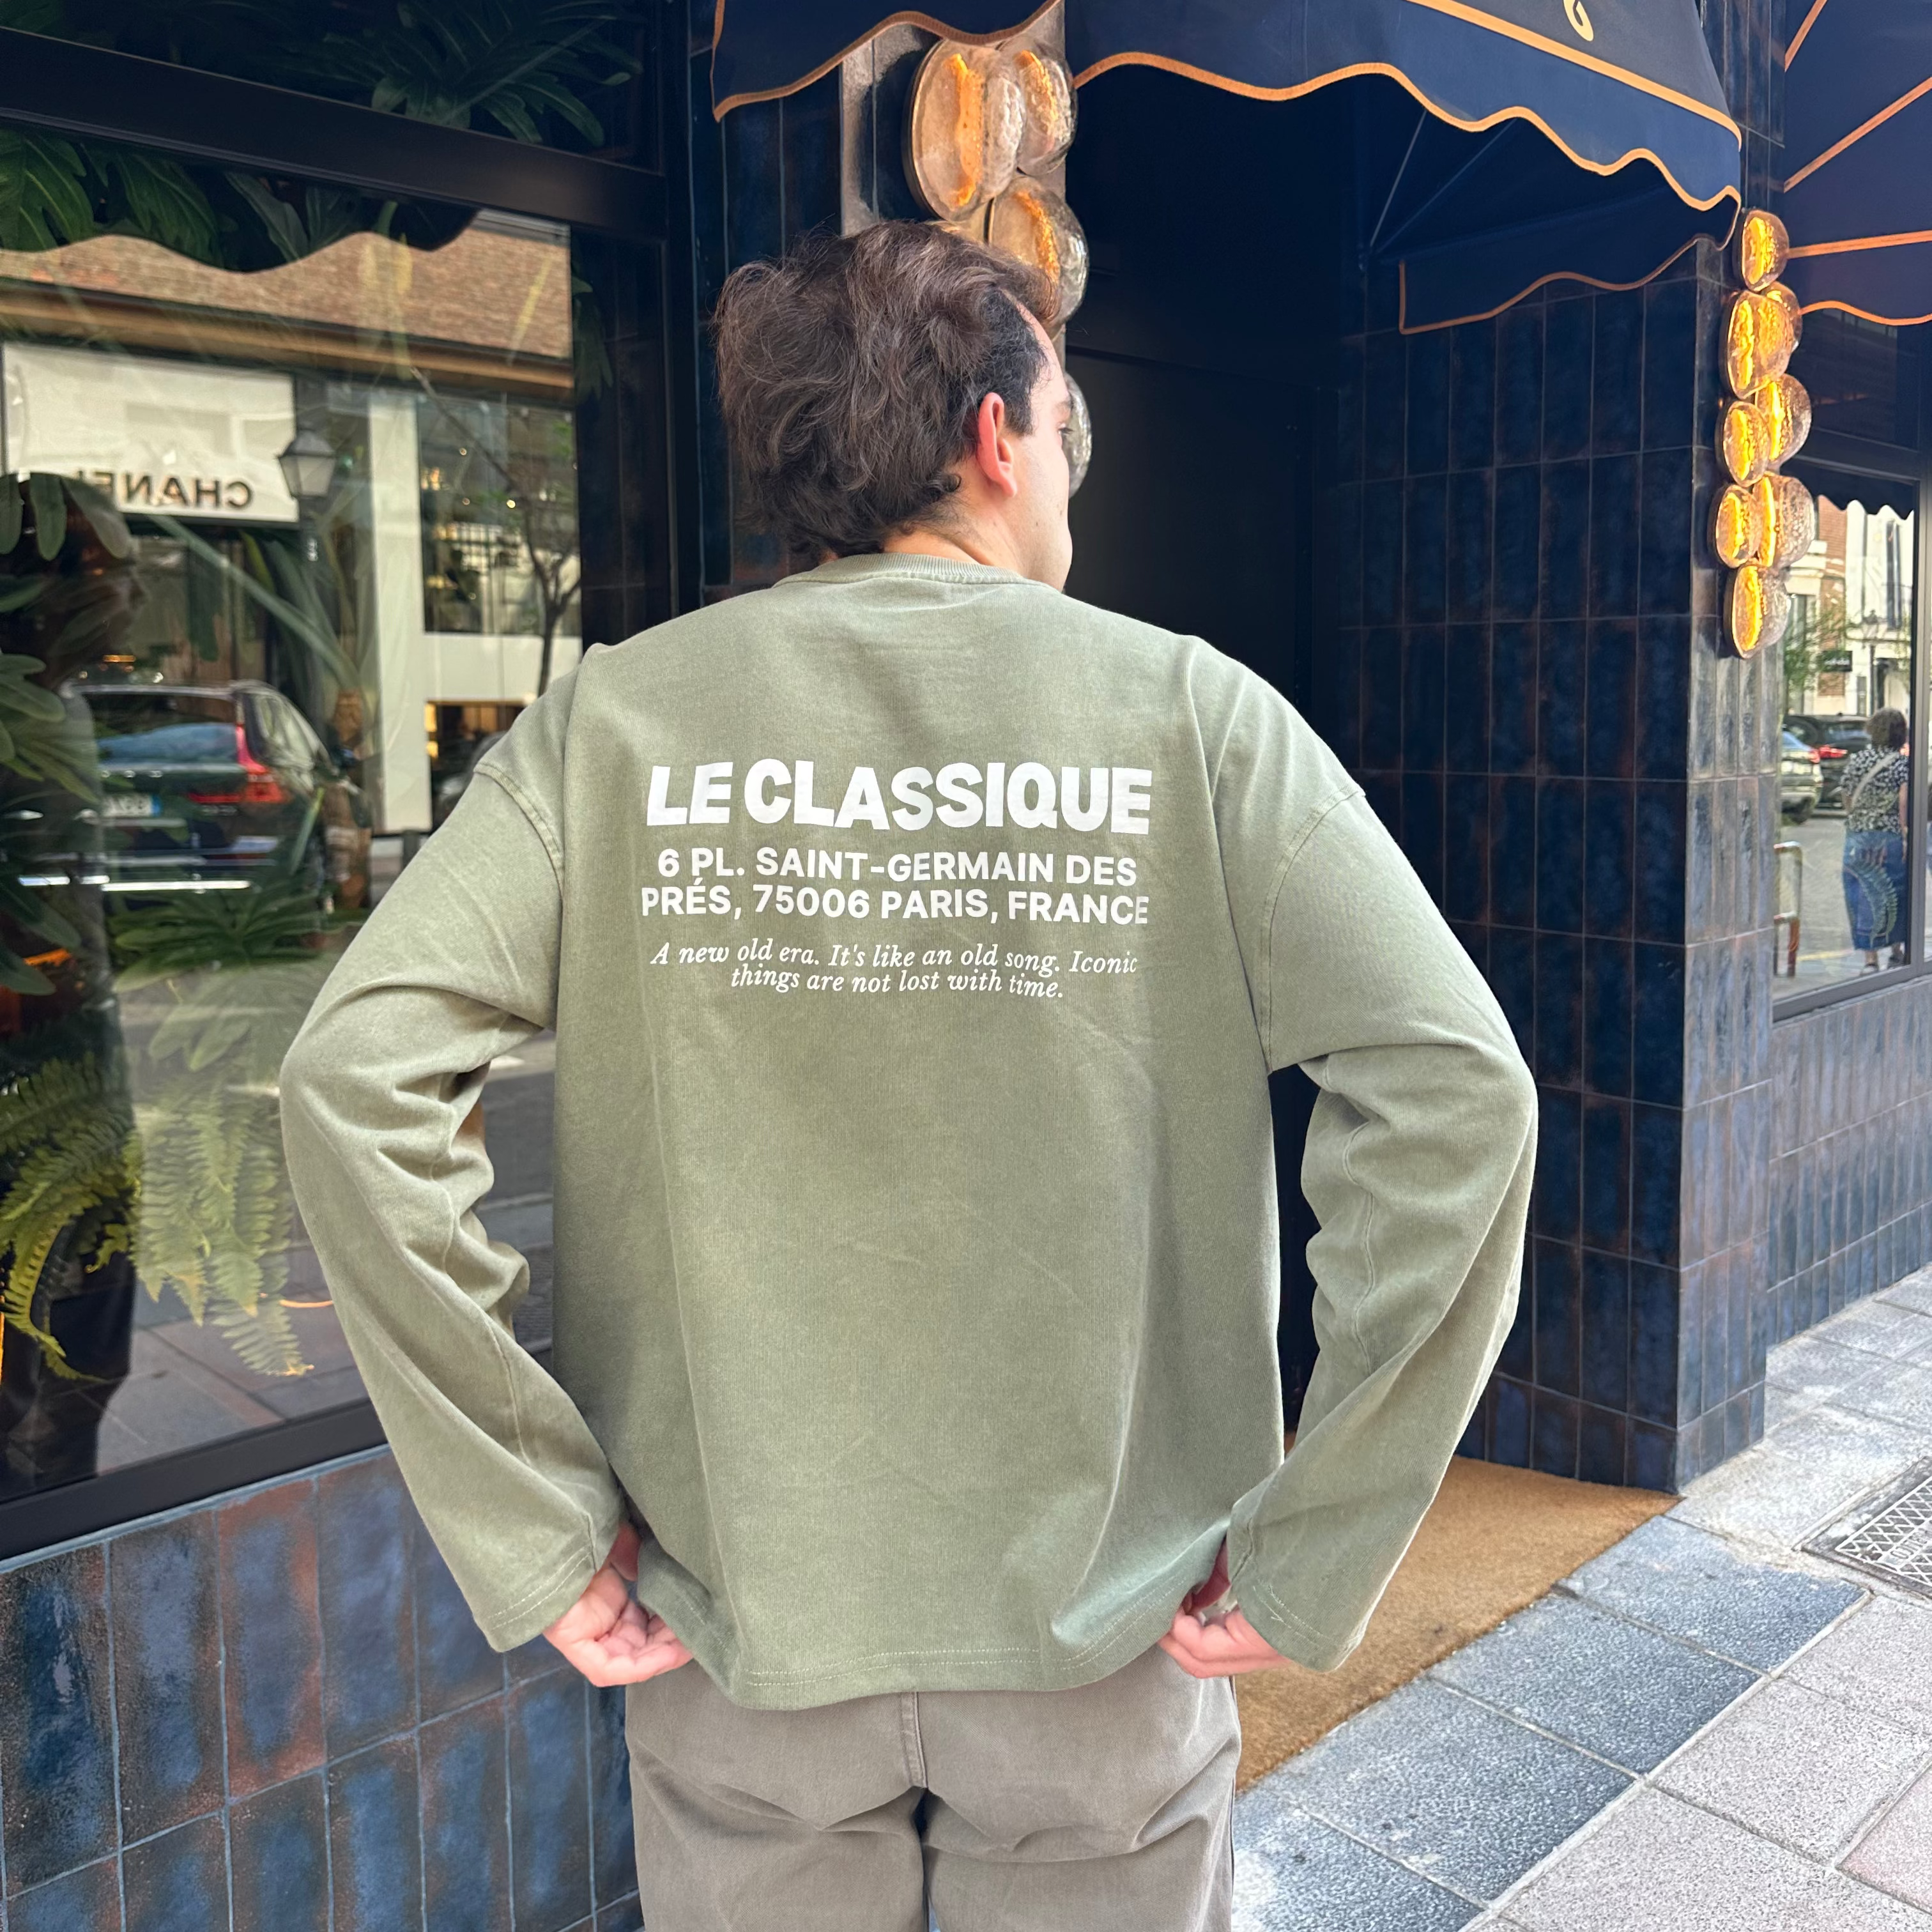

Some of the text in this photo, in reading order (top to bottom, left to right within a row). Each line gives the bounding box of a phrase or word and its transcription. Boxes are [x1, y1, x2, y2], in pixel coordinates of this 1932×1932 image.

[647, 758, 1153, 835] LE CLASSIQUE
[657, 847, 1137, 887] 6 PL. SAINT-GERMAIN DES
[641, 878, 1149, 925] PRÉS, 75006 PARIS, FRANCE
[650, 938, 1138, 978] A new old era. It's like an old song. Iconic
[731, 963, 1063, 998] things are not lost with time.
